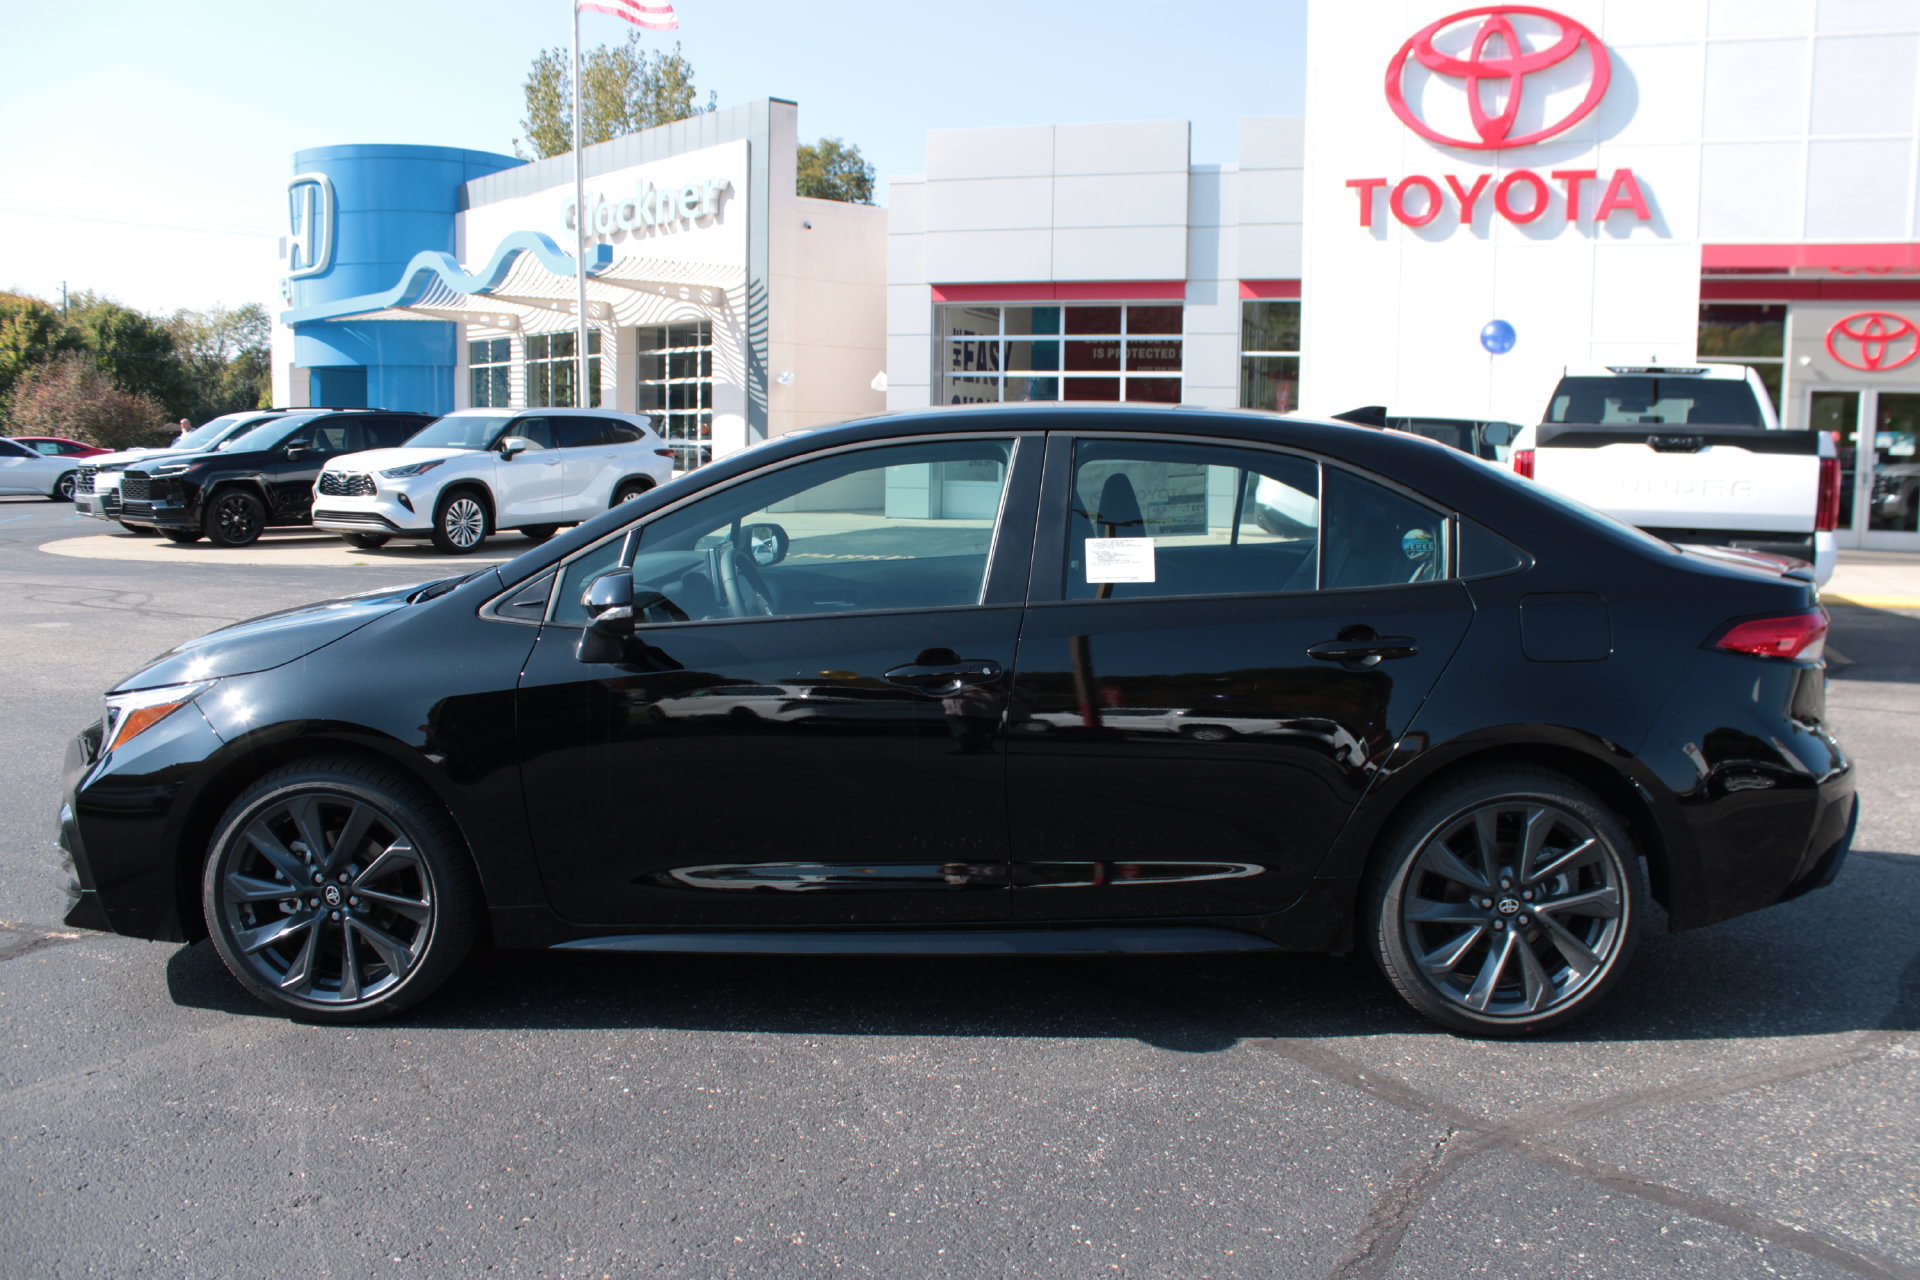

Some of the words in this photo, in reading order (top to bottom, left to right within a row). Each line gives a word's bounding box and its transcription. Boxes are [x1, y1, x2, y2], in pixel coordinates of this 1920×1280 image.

[560, 176, 731, 240] Glockner
[1345, 168, 1651, 227] TOYOTA
[1093, 348, 1104, 359] IS
